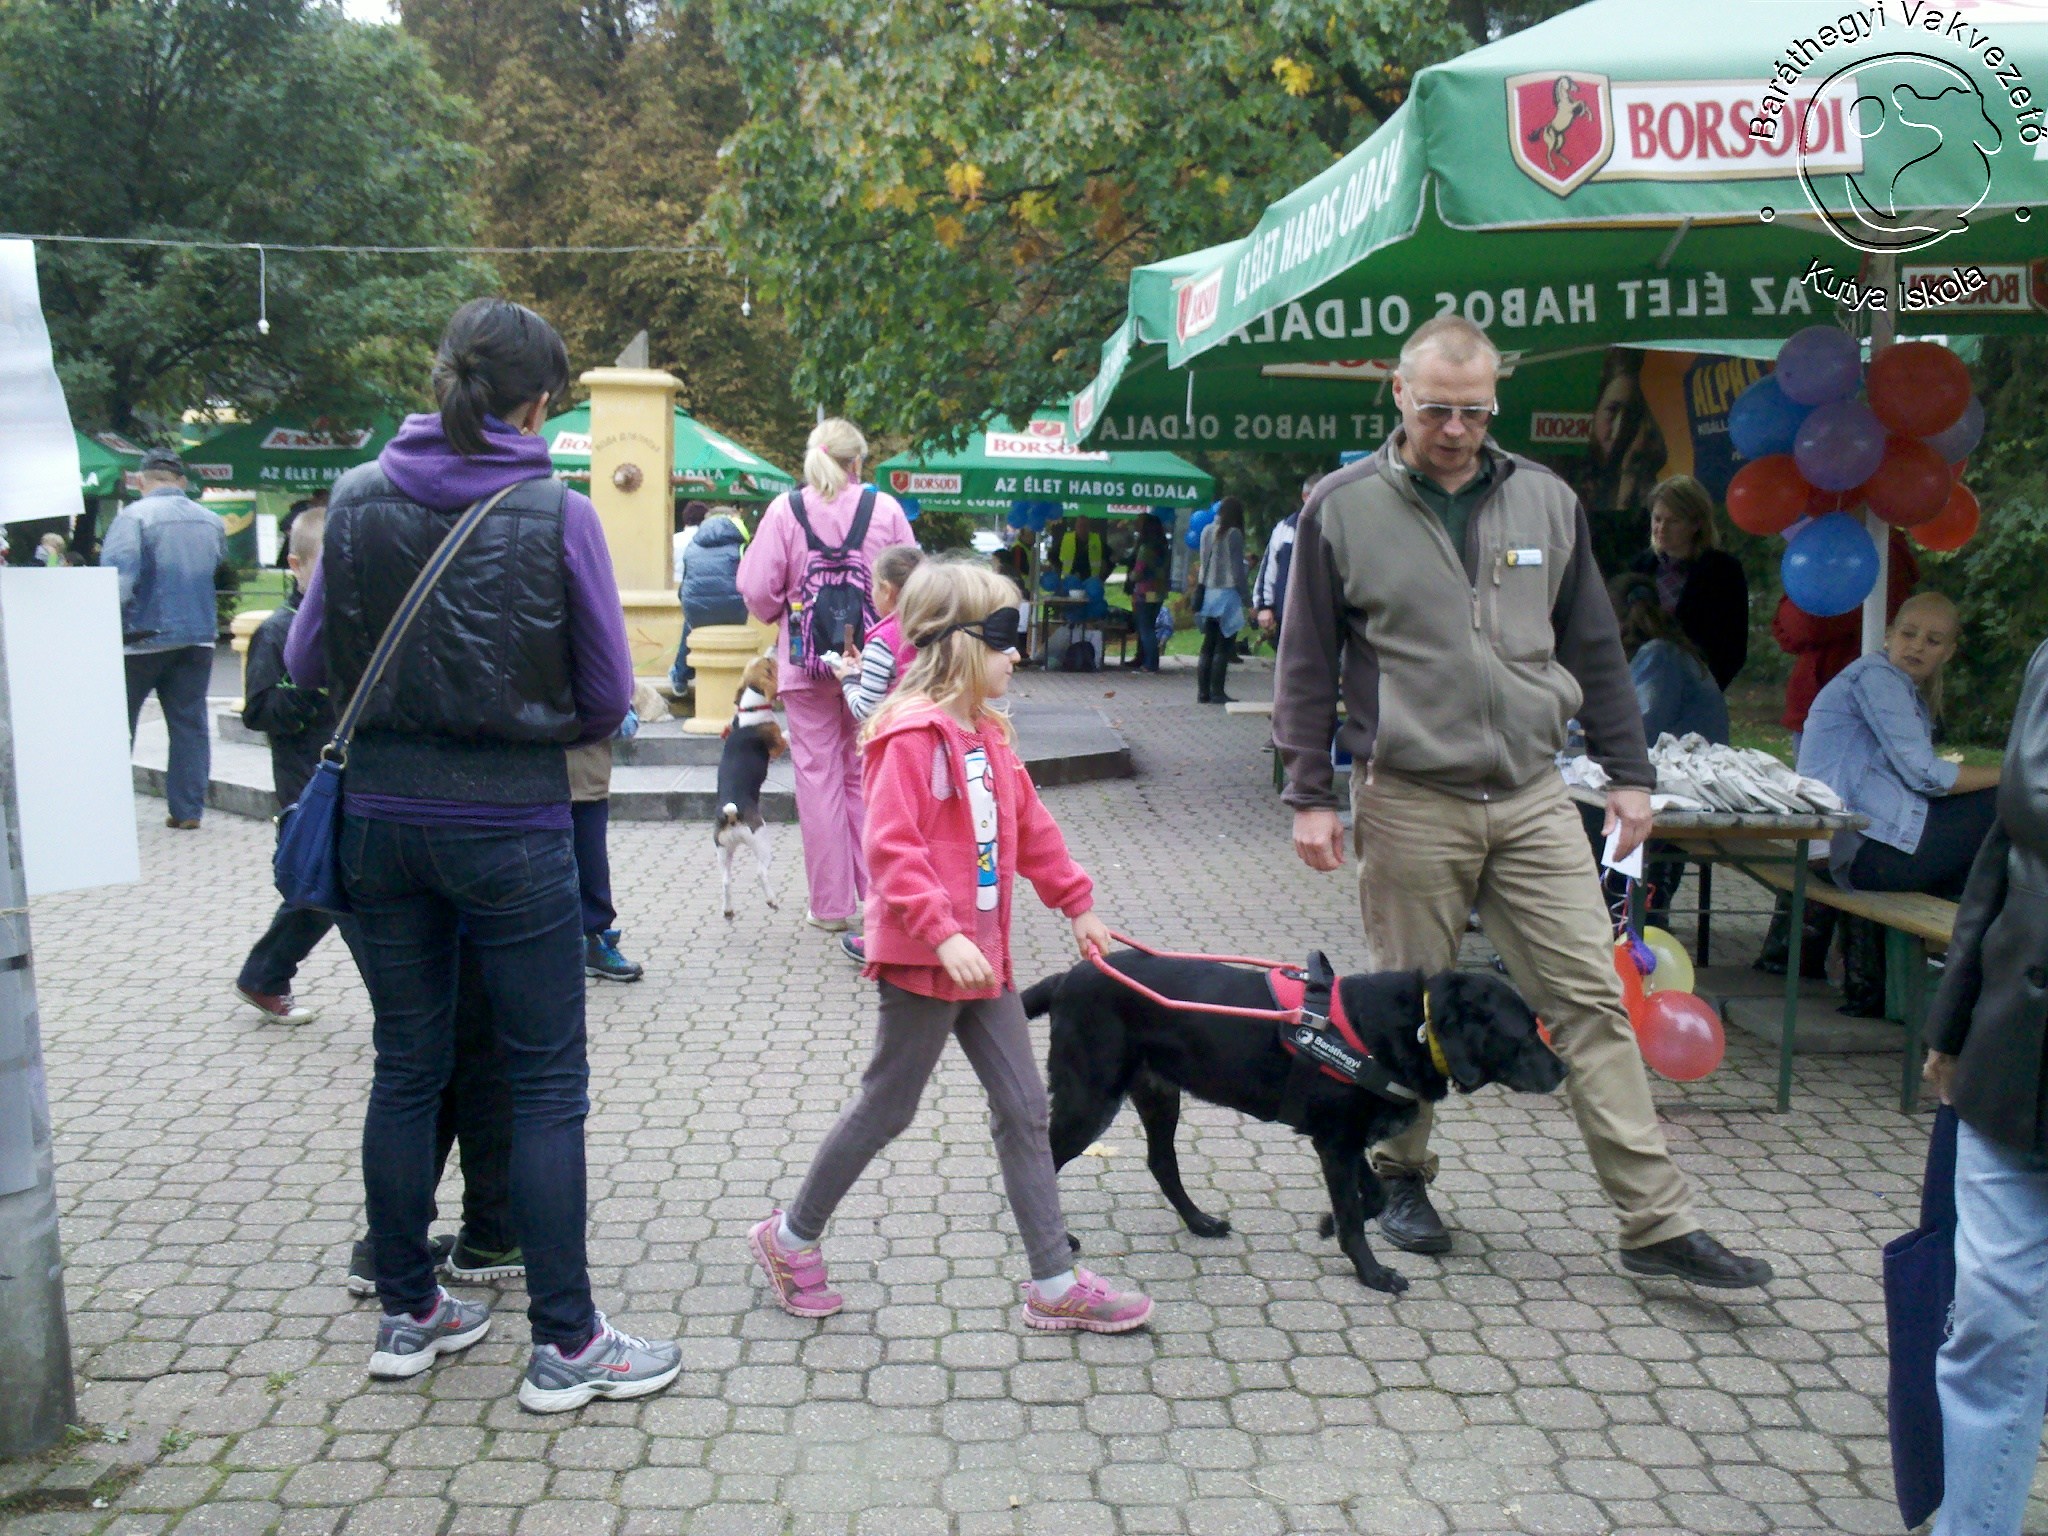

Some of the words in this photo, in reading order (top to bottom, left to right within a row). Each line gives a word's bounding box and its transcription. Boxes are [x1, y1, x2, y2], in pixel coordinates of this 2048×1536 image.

[1627, 98, 1847, 161] BORSODI
[1278, 185, 1341, 274] HABOS
[993, 439, 1101, 455] BORSO
[913, 477, 958, 491] BORSODI
[995, 478, 1017, 493] AZ
[1023, 475, 1062, 495] ÉLET
[1069, 480, 1125, 498] HABOS
[1132, 482, 1198, 500] OLDALA
